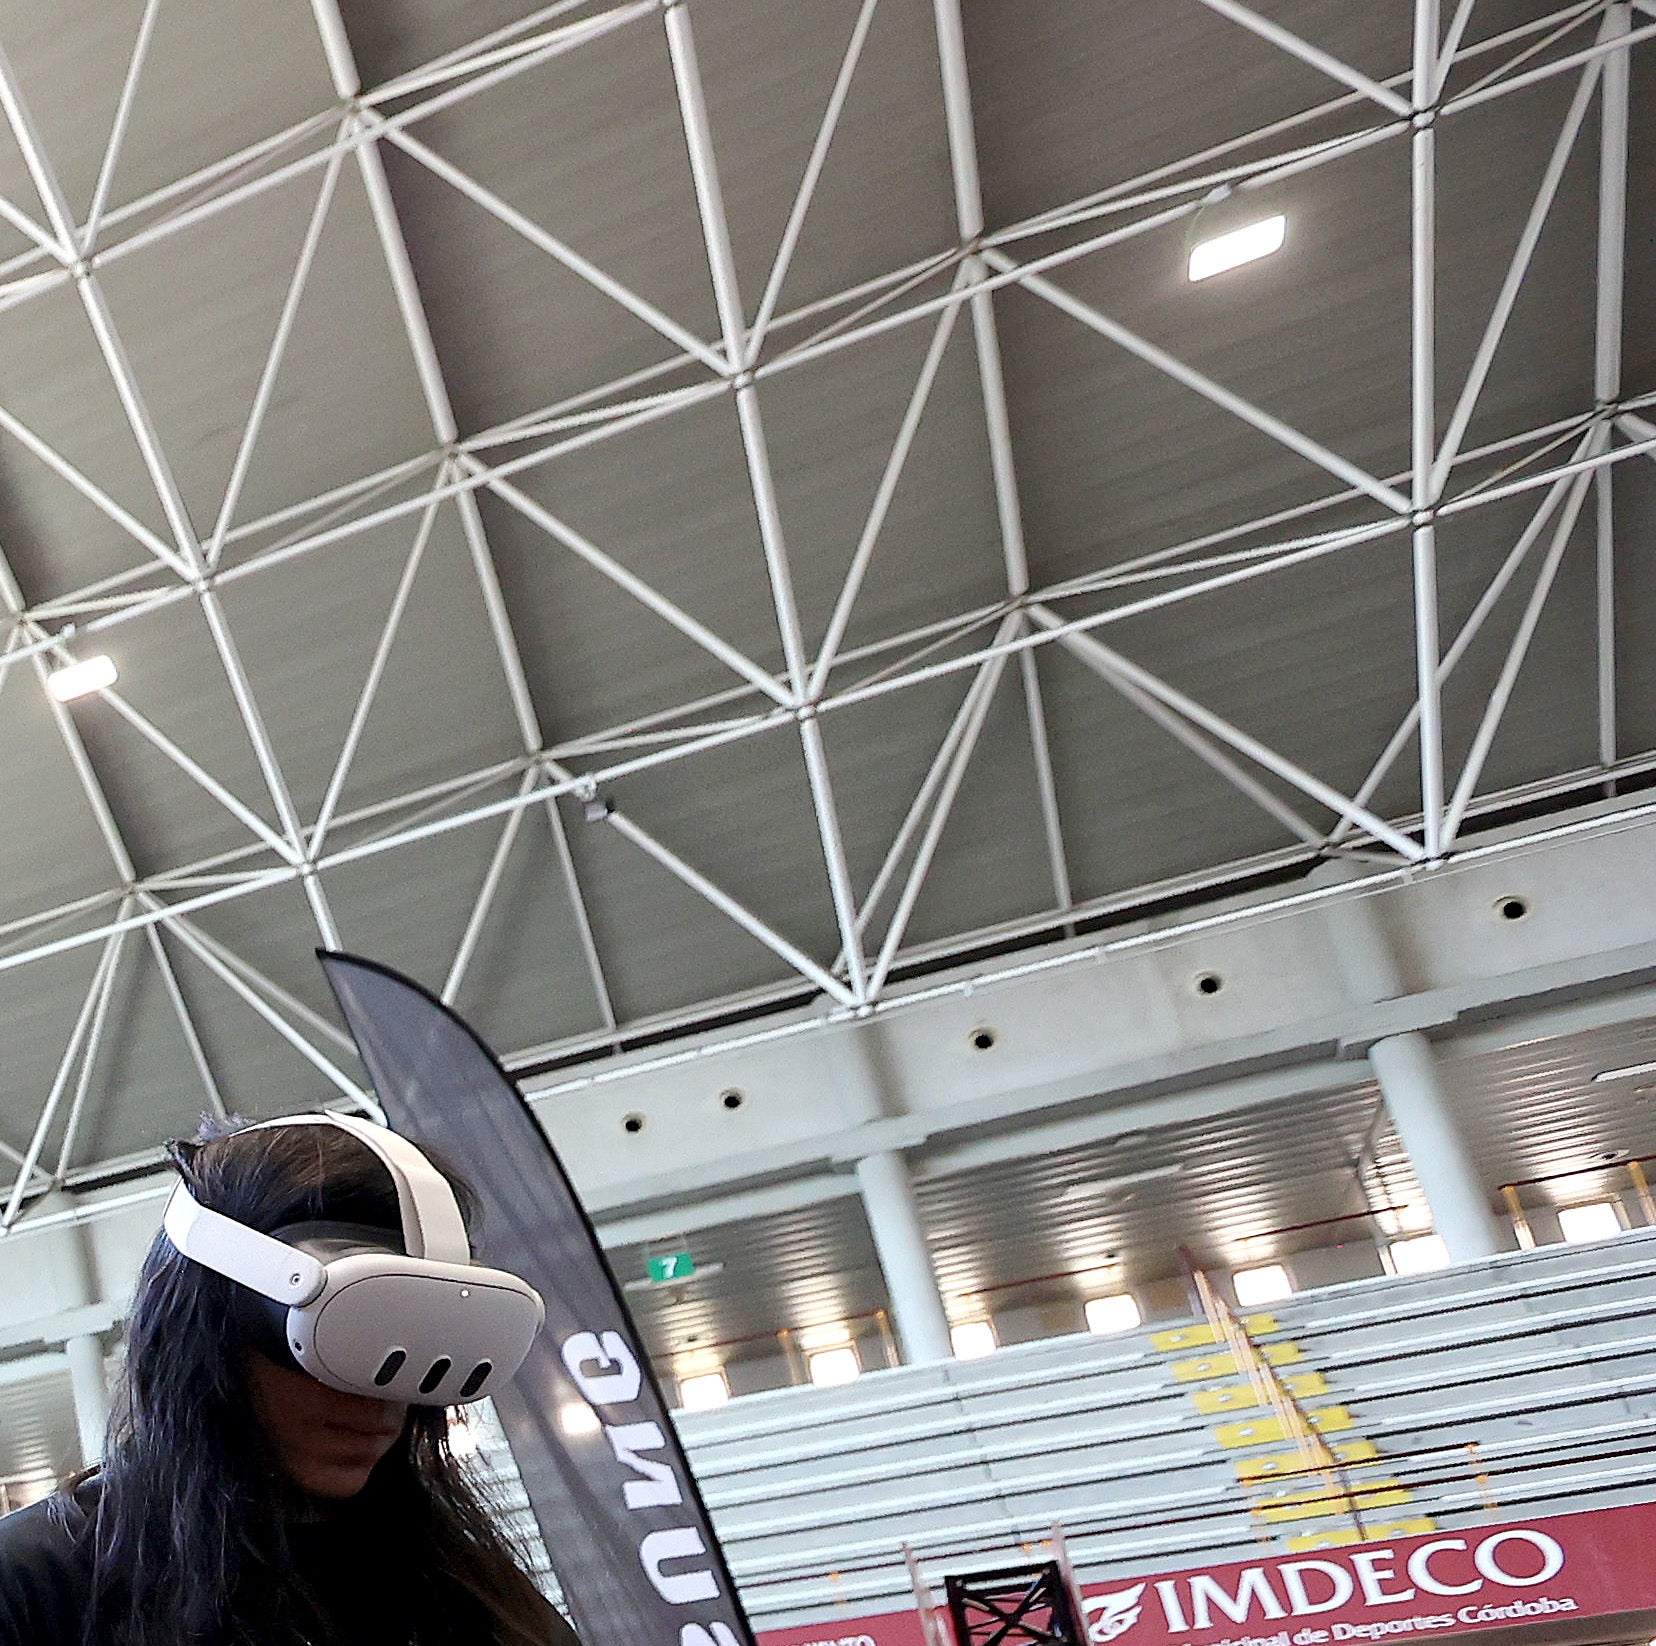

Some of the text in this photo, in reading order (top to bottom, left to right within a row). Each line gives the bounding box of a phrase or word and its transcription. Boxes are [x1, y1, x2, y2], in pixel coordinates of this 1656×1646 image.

[659, 1257, 678, 1279] 7
[1154, 1528, 1566, 1634] IMDECO
[1293, 1627, 1329, 1646] de
[1334, 1611, 1456, 1642] Deportes
[1456, 1594, 1578, 1624] Córdoba
